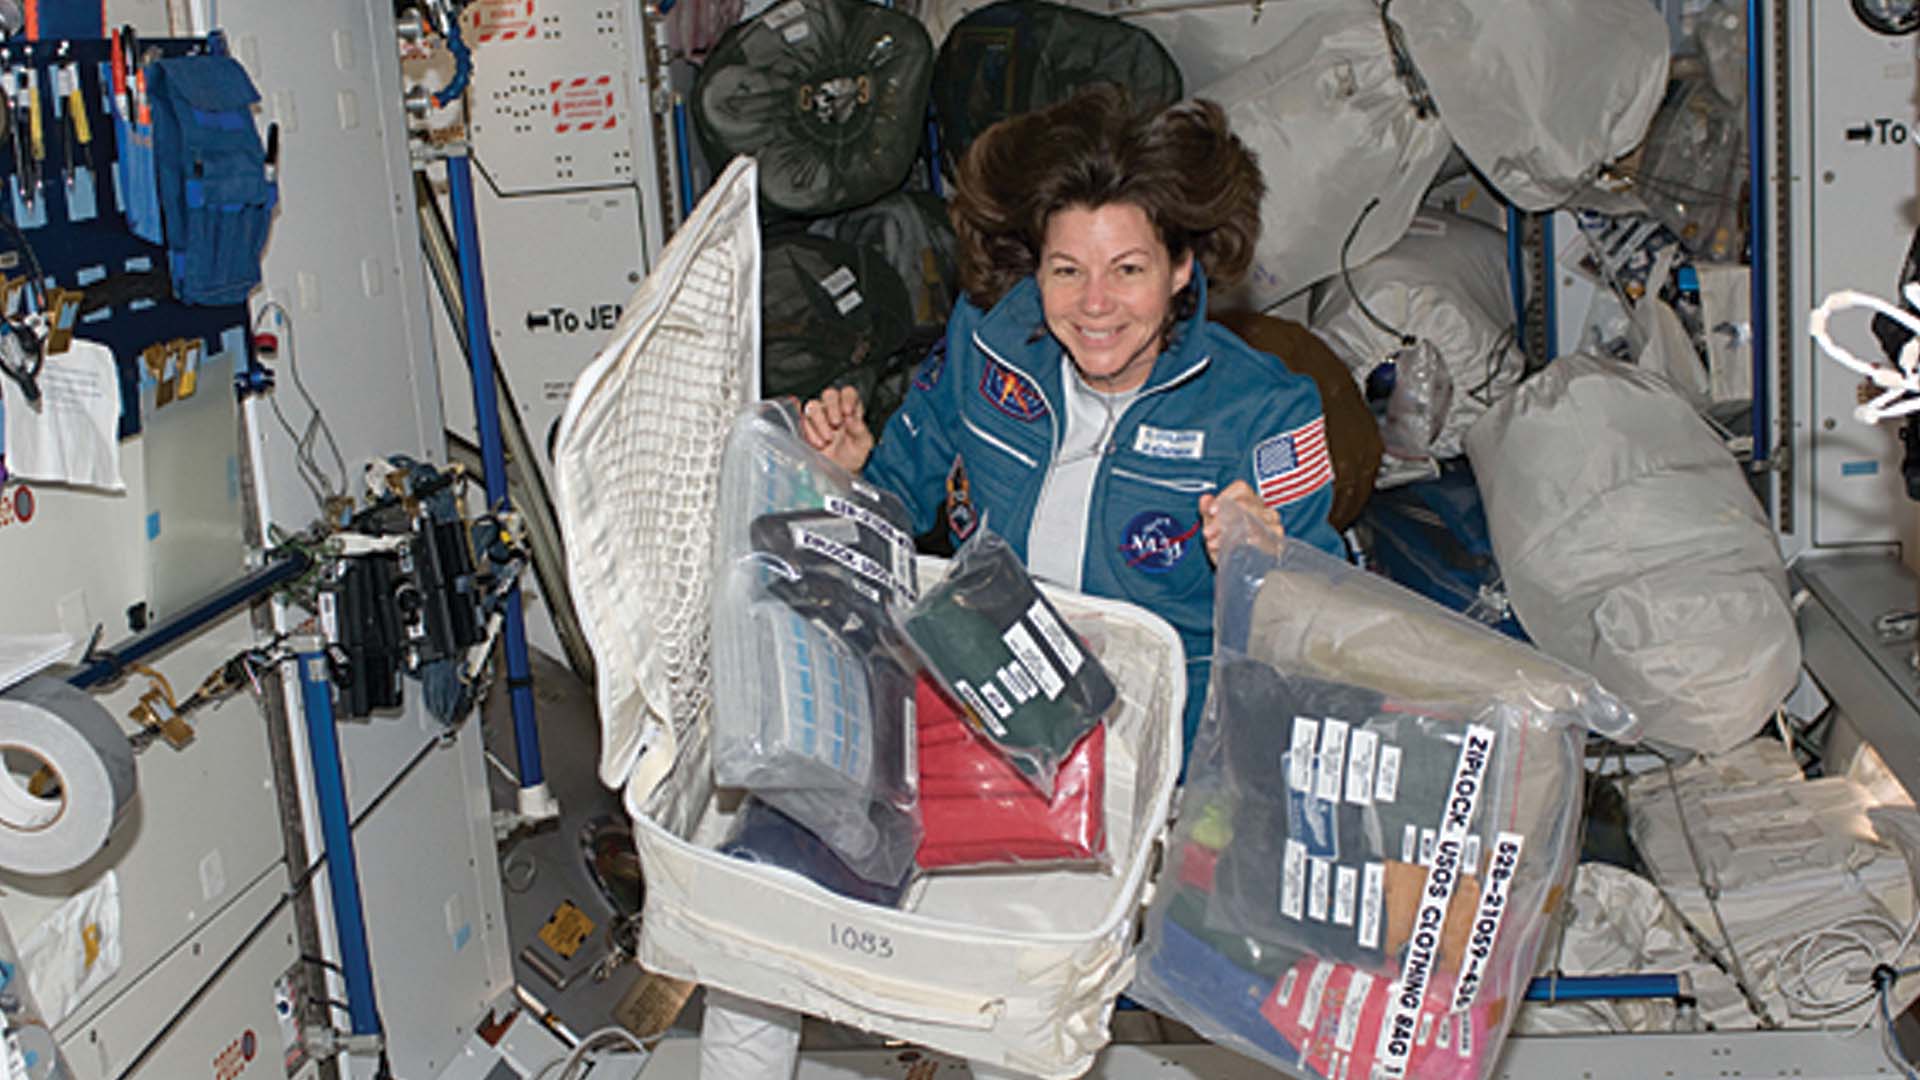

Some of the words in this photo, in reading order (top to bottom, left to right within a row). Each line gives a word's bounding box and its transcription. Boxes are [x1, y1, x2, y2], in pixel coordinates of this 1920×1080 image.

[1874, 118, 1907, 145] To
[548, 307, 579, 333] To
[1428, 841, 1460, 898] USOS
[830, 921, 893, 959] 1083
[1400, 905, 1442, 1009] CLOTHING
[1387, 1013, 1415, 1057] BAG
